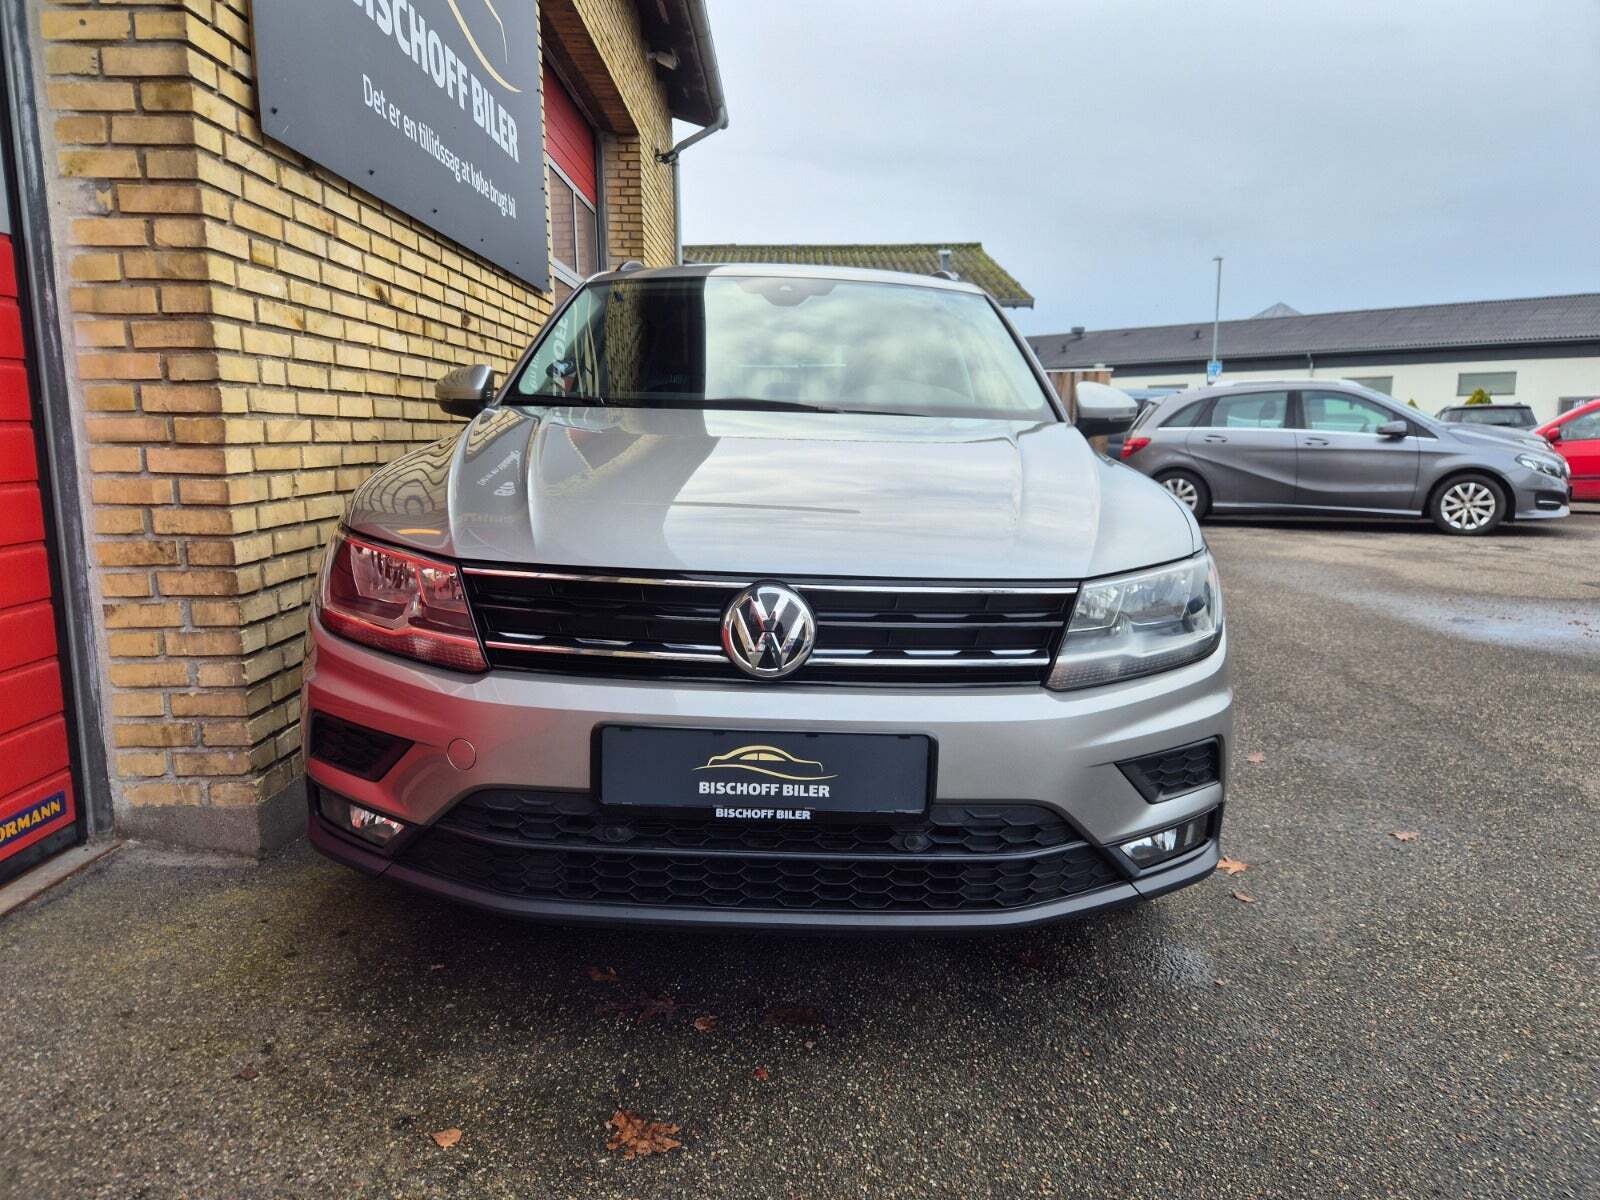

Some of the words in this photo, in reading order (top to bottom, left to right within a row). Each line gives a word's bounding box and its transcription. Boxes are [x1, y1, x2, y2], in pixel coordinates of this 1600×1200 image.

[353, 0, 468, 110] SCHOFF
[470, 73, 519, 163] BILER
[362, 73, 387, 119] Det
[389, 103, 400, 129] er
[403, 115, 417, 143] en
[418, 121, 461, 183] tillidssag
[461, 161, 471, 184] at
[470, 163, 489, 199] købe
[489, 179, 508, 216] brugt
[507, 194, 516, 219] bil
[698, 781, 780, 796] BISCHOFF
[782, 784, 830, 798] BILER
[0, 799, 61, 842] ORMANN
[715, 808, 774, 819] BISCHOFF
[776, 809, 811, 820] BILER
